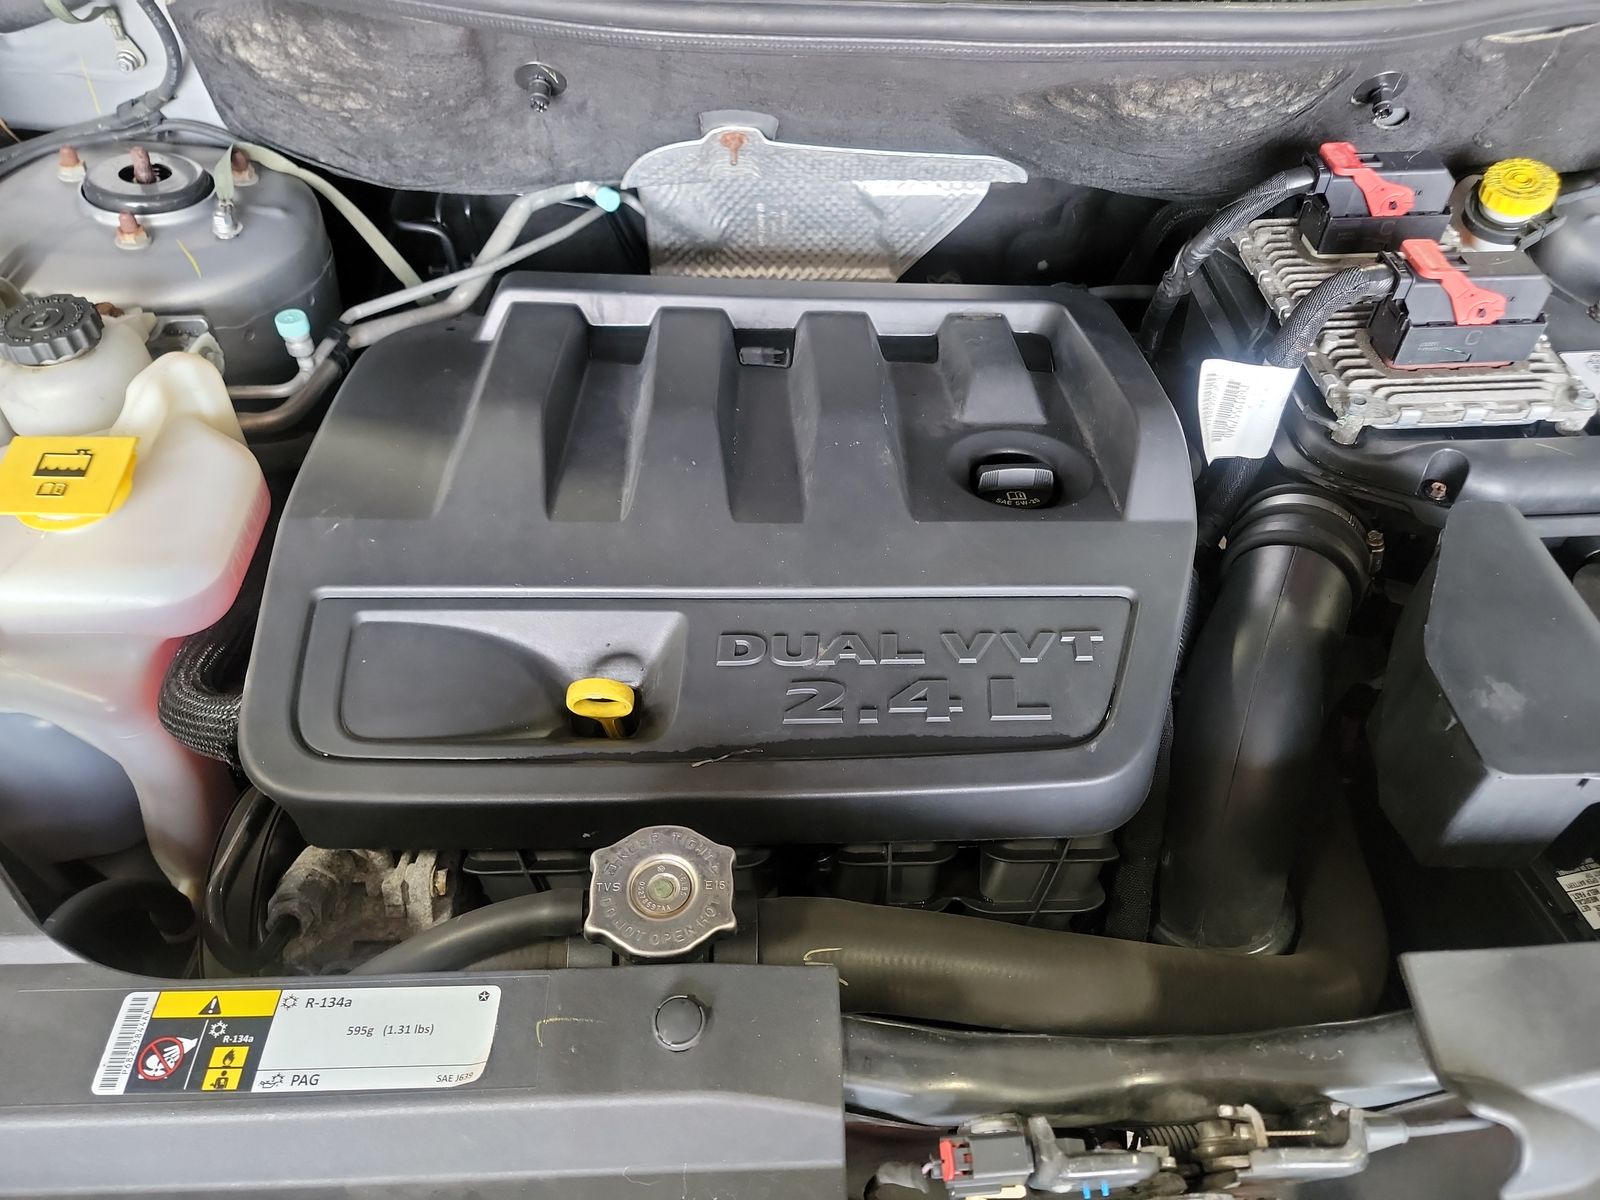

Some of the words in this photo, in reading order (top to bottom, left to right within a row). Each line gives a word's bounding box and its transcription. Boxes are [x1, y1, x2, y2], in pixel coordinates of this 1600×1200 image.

[995, 497, 1012, 506] SAE
[716, 632, 926, 666] DUAL
[940, 630, 1104, 664] VVT
[782, 679, 964, 724] 2.4
[986, 677, 1053, 722] L
[596, 881, 622, 893] TVS
[648, 923, 697, 946] OPEN
[305, 997, 352, 1009] R-134a
[346, 1026, 374, 1037] 595g
[383, 1025, 411, 1037] (1.31
[414, 1023, 434, 1036] lbs)
[120, 1010, 151, 1075] P68253844AA
[222, 1034, 255, 1044] R-134a
[290, 1073, 320, 1087] PAG
[436, 1074, 453, 1083] SAE
[455, 1071, 474, 1082] J639
